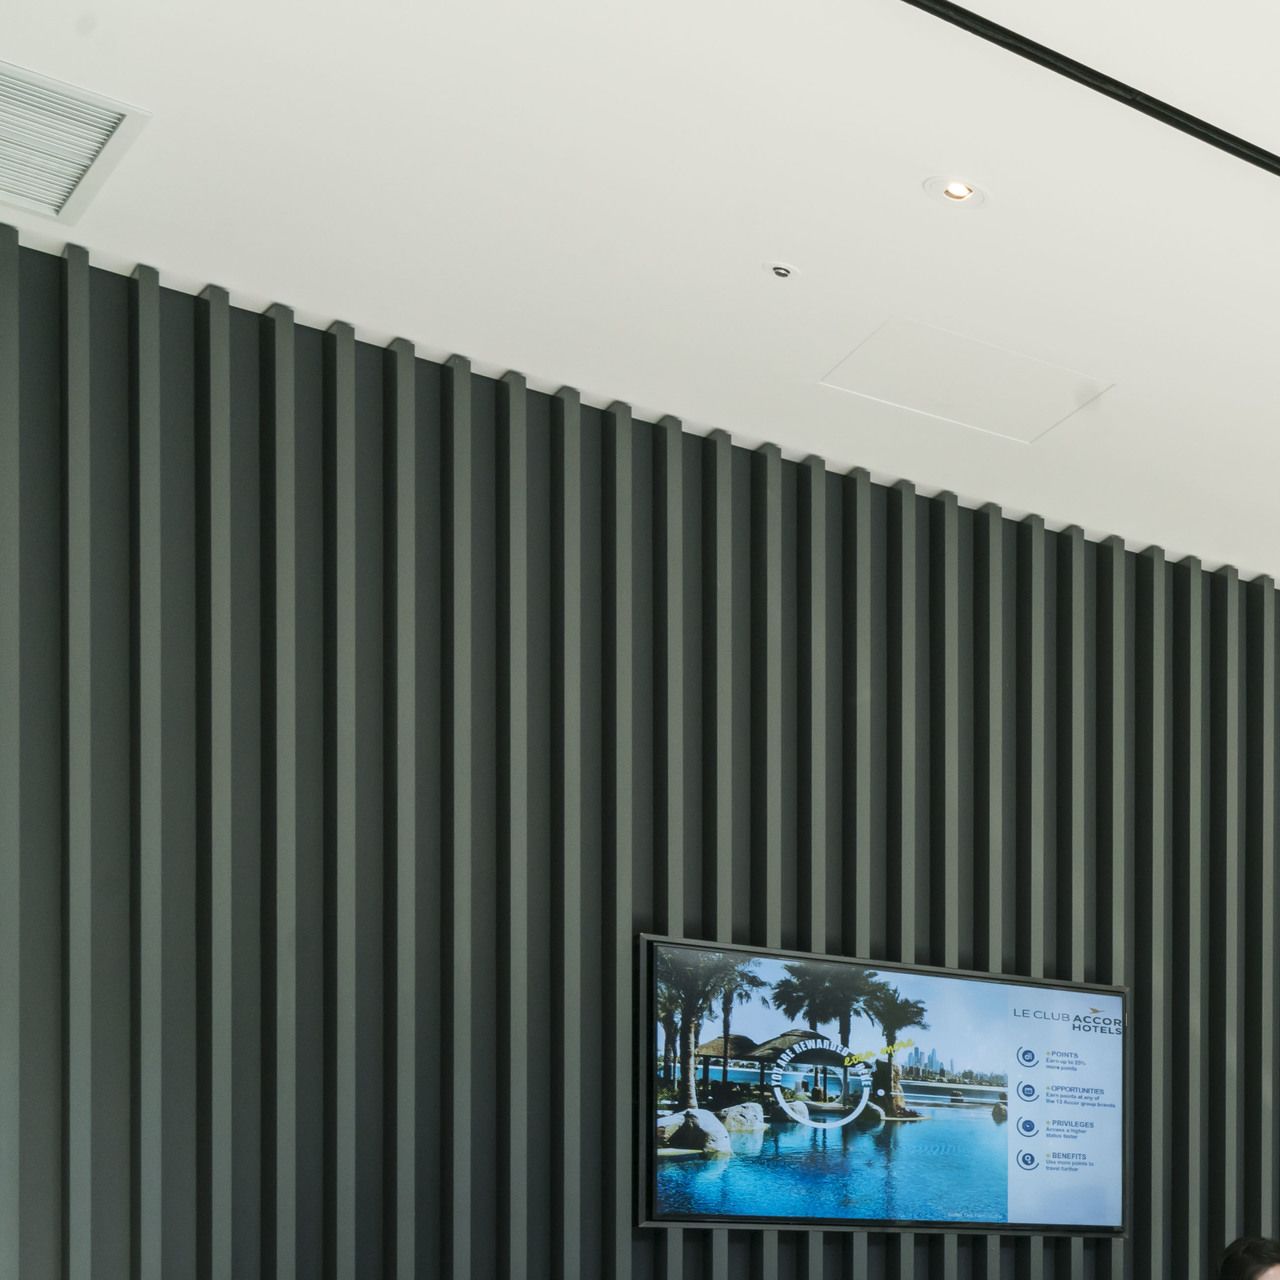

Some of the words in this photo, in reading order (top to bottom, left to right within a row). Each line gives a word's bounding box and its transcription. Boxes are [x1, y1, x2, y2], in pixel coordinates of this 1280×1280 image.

[1013, 1008, 1030, 1018] LE
[1033, 1010, 1070, 1021] CLUB
[1073, 1014, 1122, 1027] ACCOR
[1072, 1023, 1122, 1035] HOTELS
[776, 1049, 795, 1068] ARE
[793, 1038, 849, 1057] REWARDED
[1052, 1119, 1094, 1129] PRIVILEGES
[1052, 1152, 1087, 1160] BENEFITS
